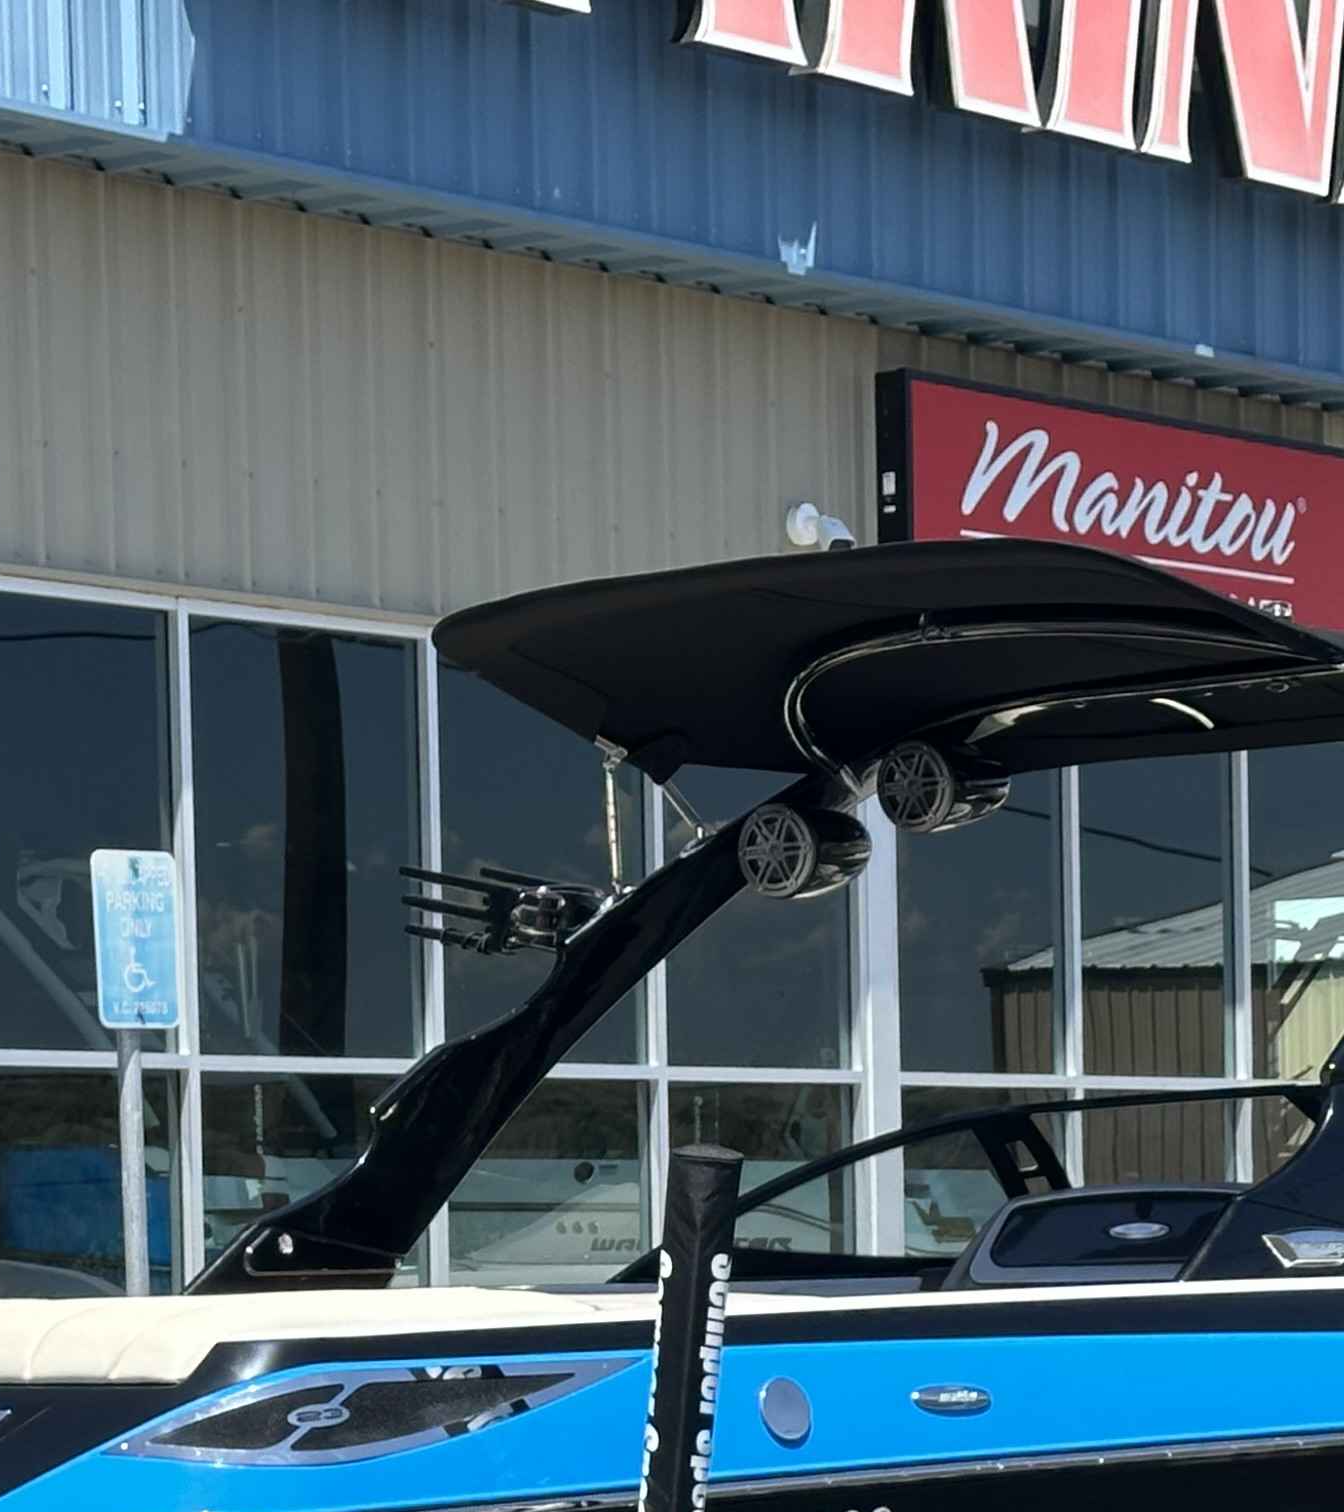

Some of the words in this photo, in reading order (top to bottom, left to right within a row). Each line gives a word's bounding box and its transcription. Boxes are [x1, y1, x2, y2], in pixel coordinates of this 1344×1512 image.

[959, 419, 1297, 567] Manitou
[106, 890, 166, 912] PARKING
[120, 917, 153, 937] ONLY
